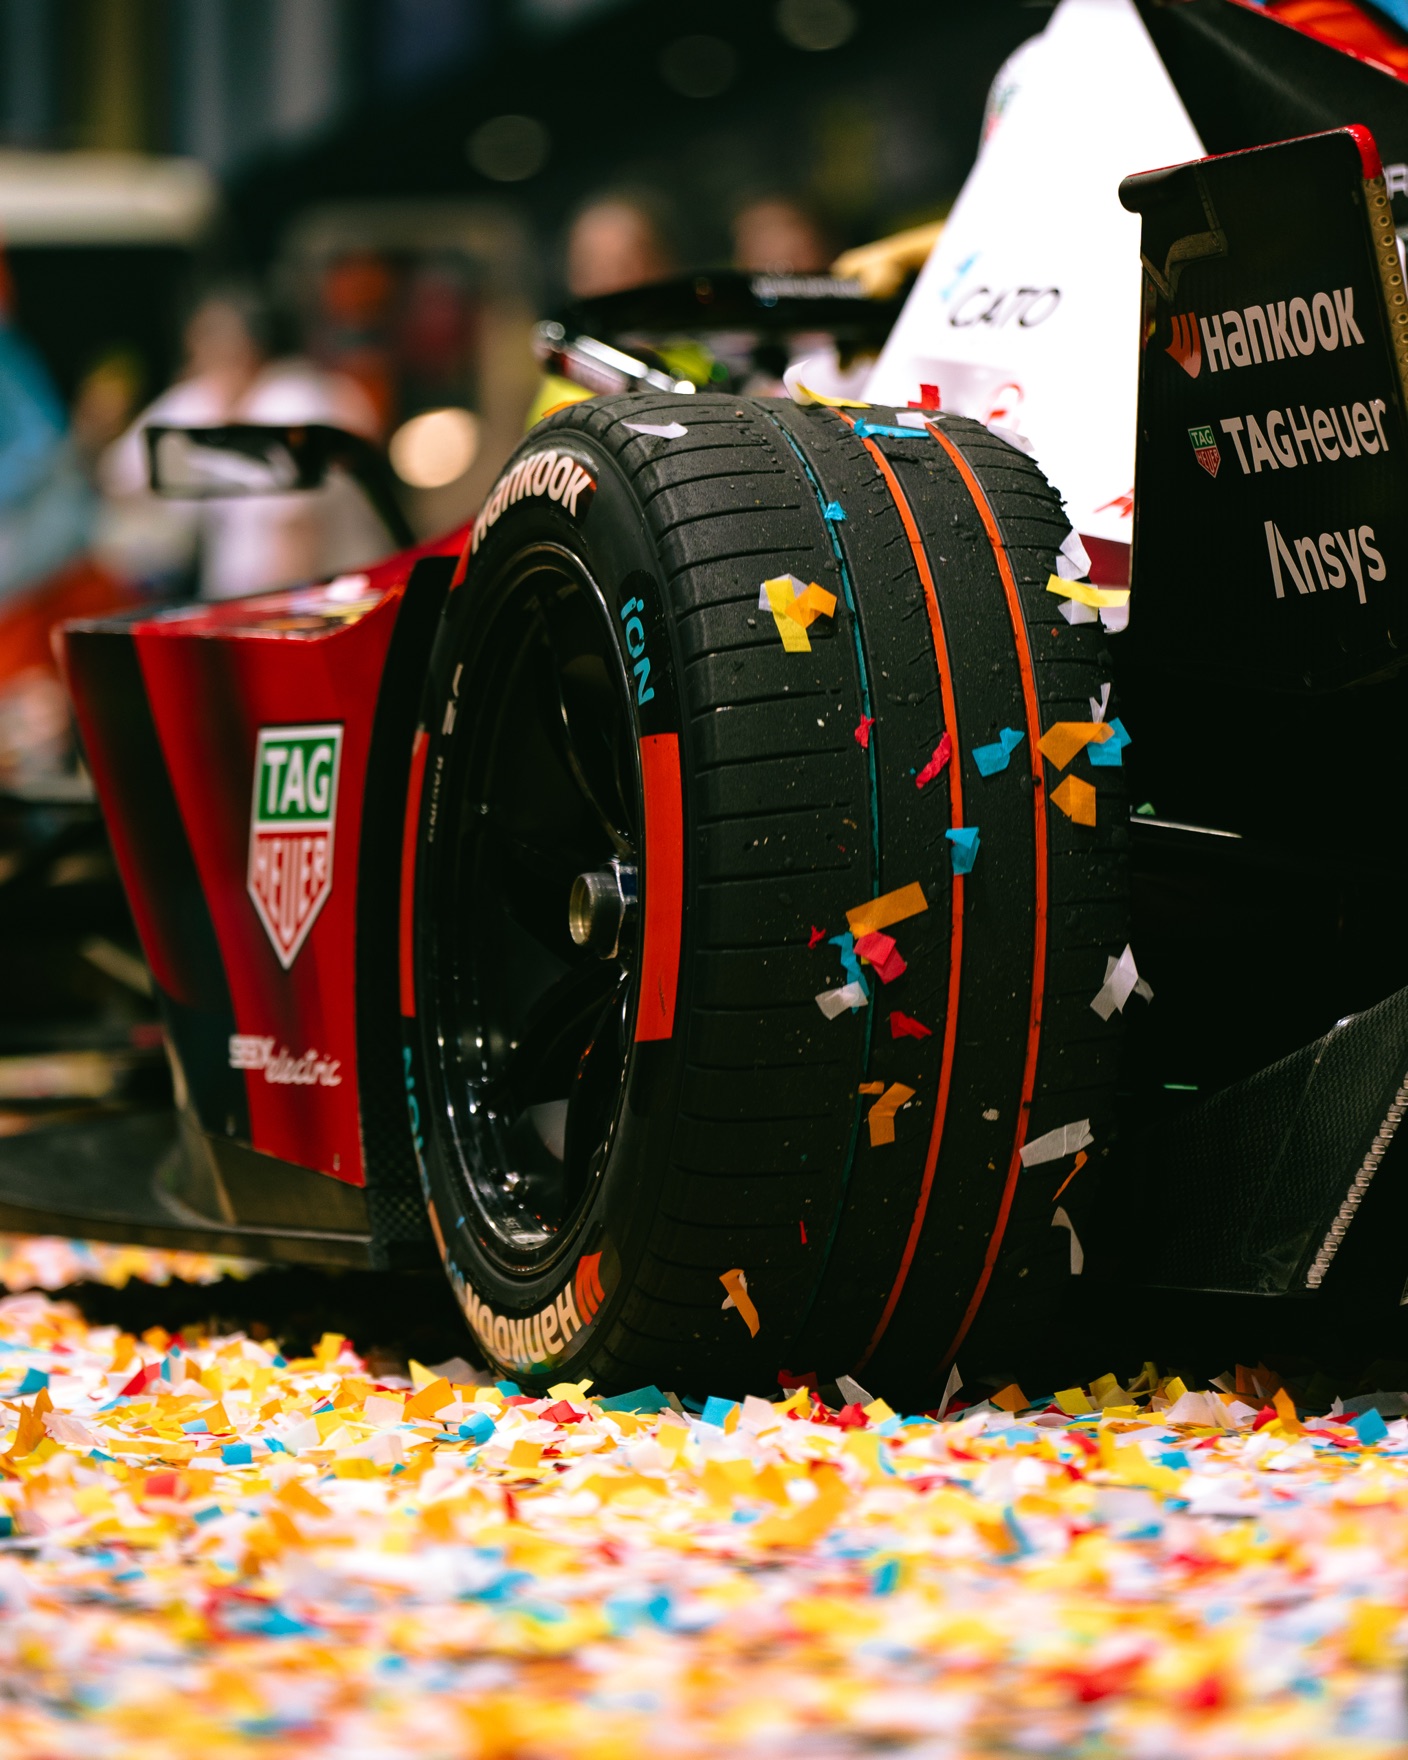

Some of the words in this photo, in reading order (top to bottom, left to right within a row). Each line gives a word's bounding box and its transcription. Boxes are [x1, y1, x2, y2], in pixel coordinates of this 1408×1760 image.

[1191, 429, 1213, 446] TAG
[1264, 520, 1387, 604] Ansys
[264, 743, 333, 815] TAG
[253, 835, 329, 945] HEUER
